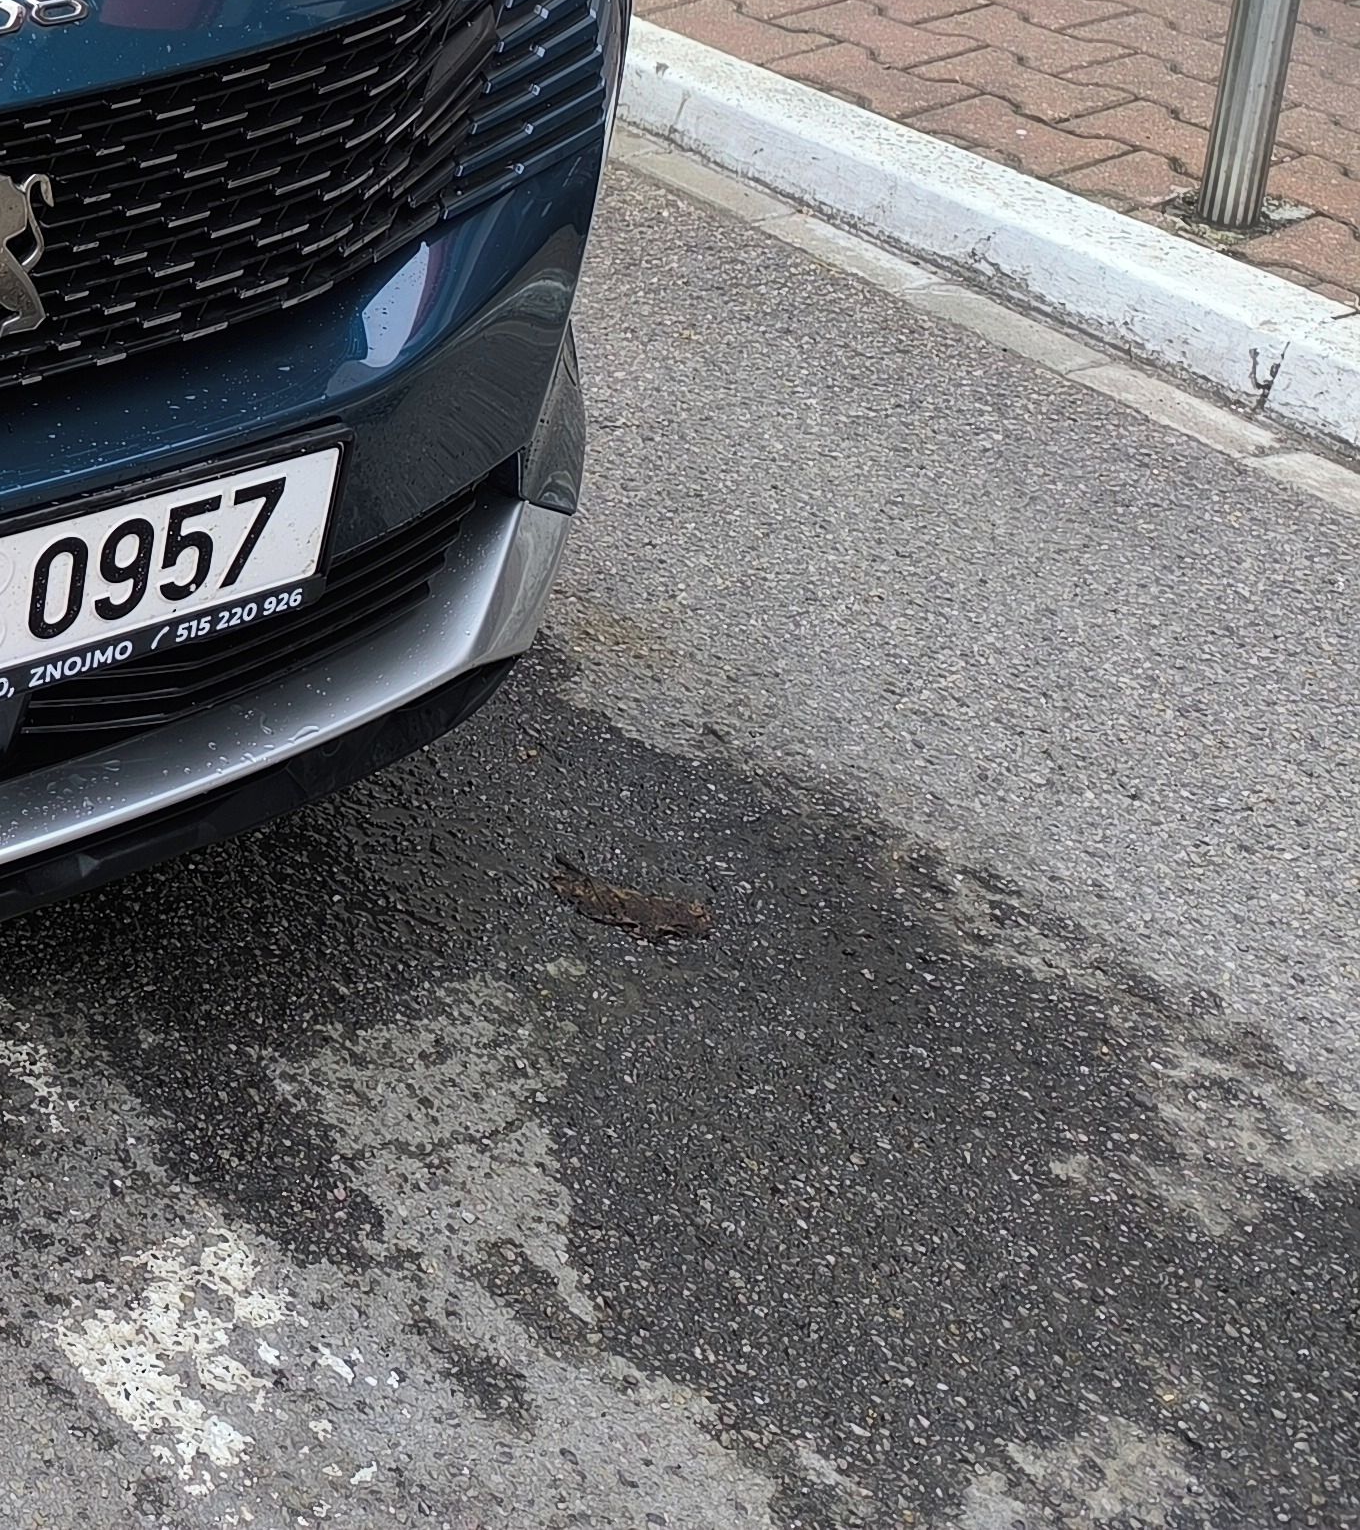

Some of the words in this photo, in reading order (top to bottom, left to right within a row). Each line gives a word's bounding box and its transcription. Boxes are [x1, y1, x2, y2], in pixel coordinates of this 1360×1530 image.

[27, 477, 287, 640] 0957
[27, 640, 133, 688] ZNOJMO
[175, 615, 212, 643] 515
[215, 601, 258, 631] 220
[262, 588, 304, 617] 926
